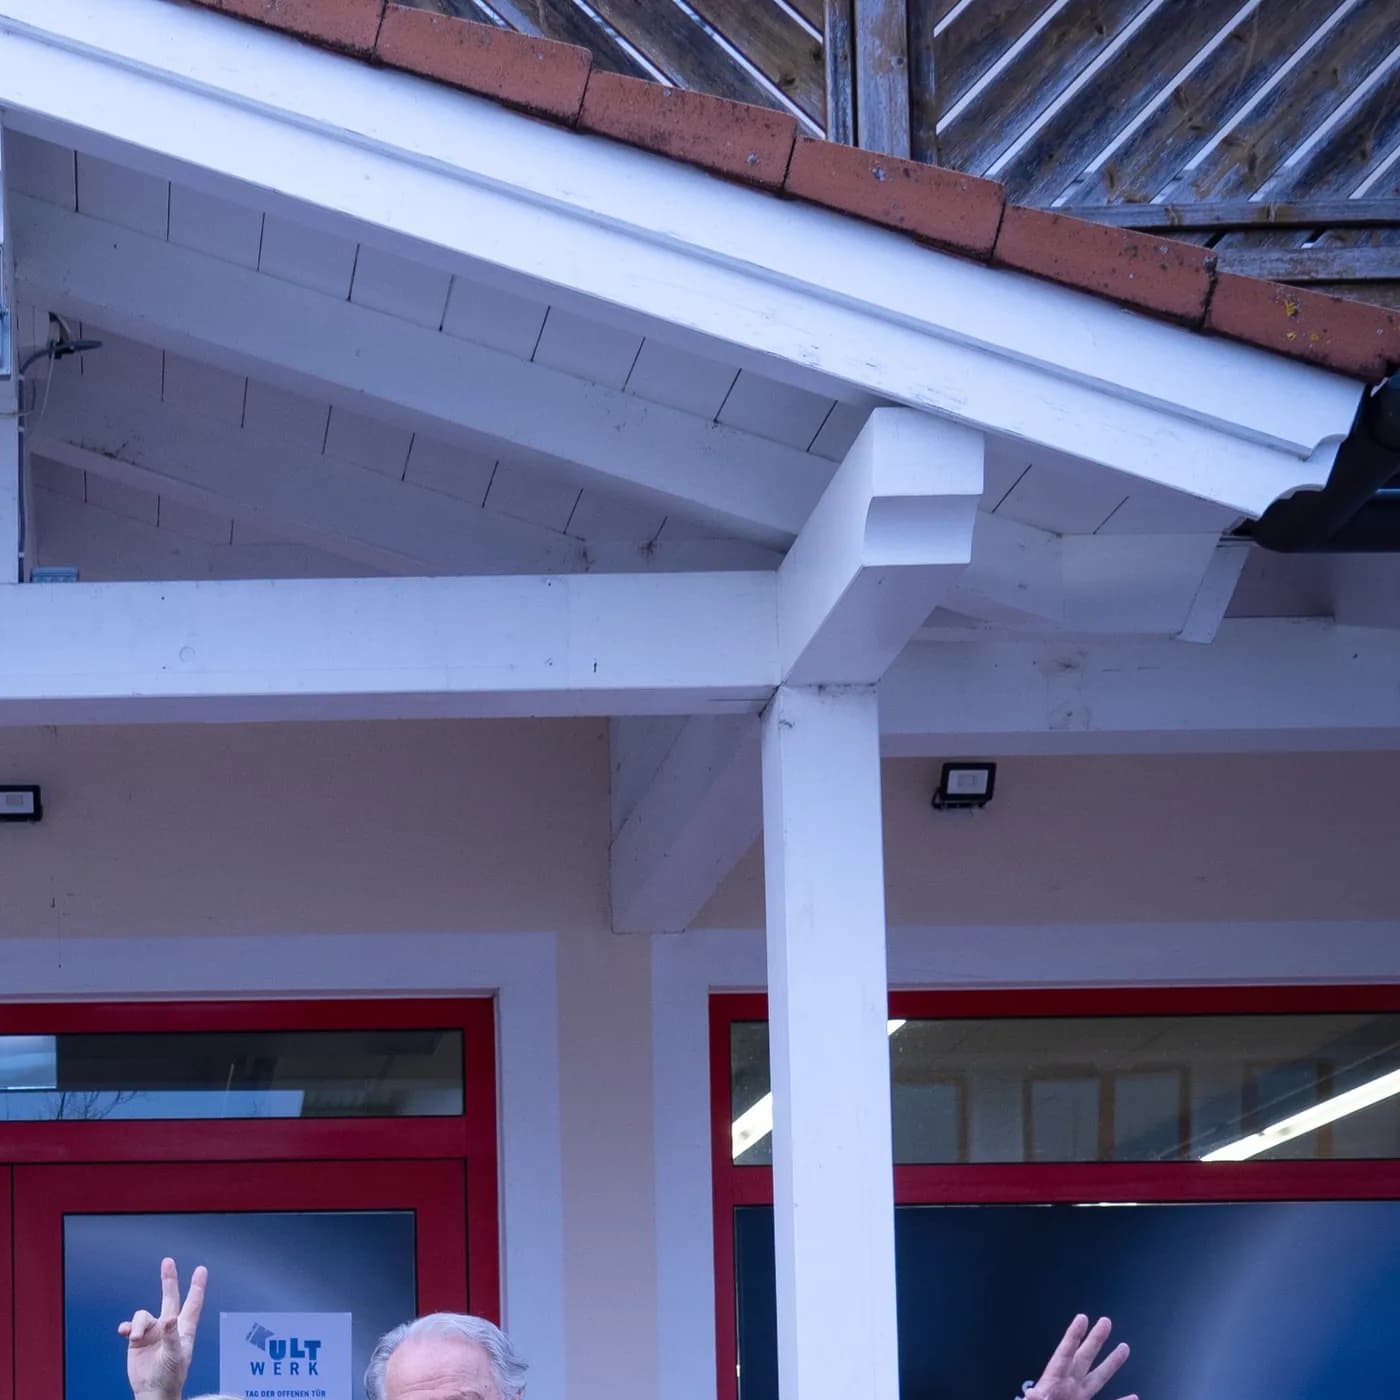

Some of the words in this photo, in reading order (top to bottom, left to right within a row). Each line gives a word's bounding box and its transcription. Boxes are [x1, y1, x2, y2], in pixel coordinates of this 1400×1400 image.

[251, 1362, 318, 1376] WERK
[261, 1390, 275, 1398] DER
[277, 1390, 310, 1398] OFFENEN
[311, 1388, 326, 1398] TÜR
